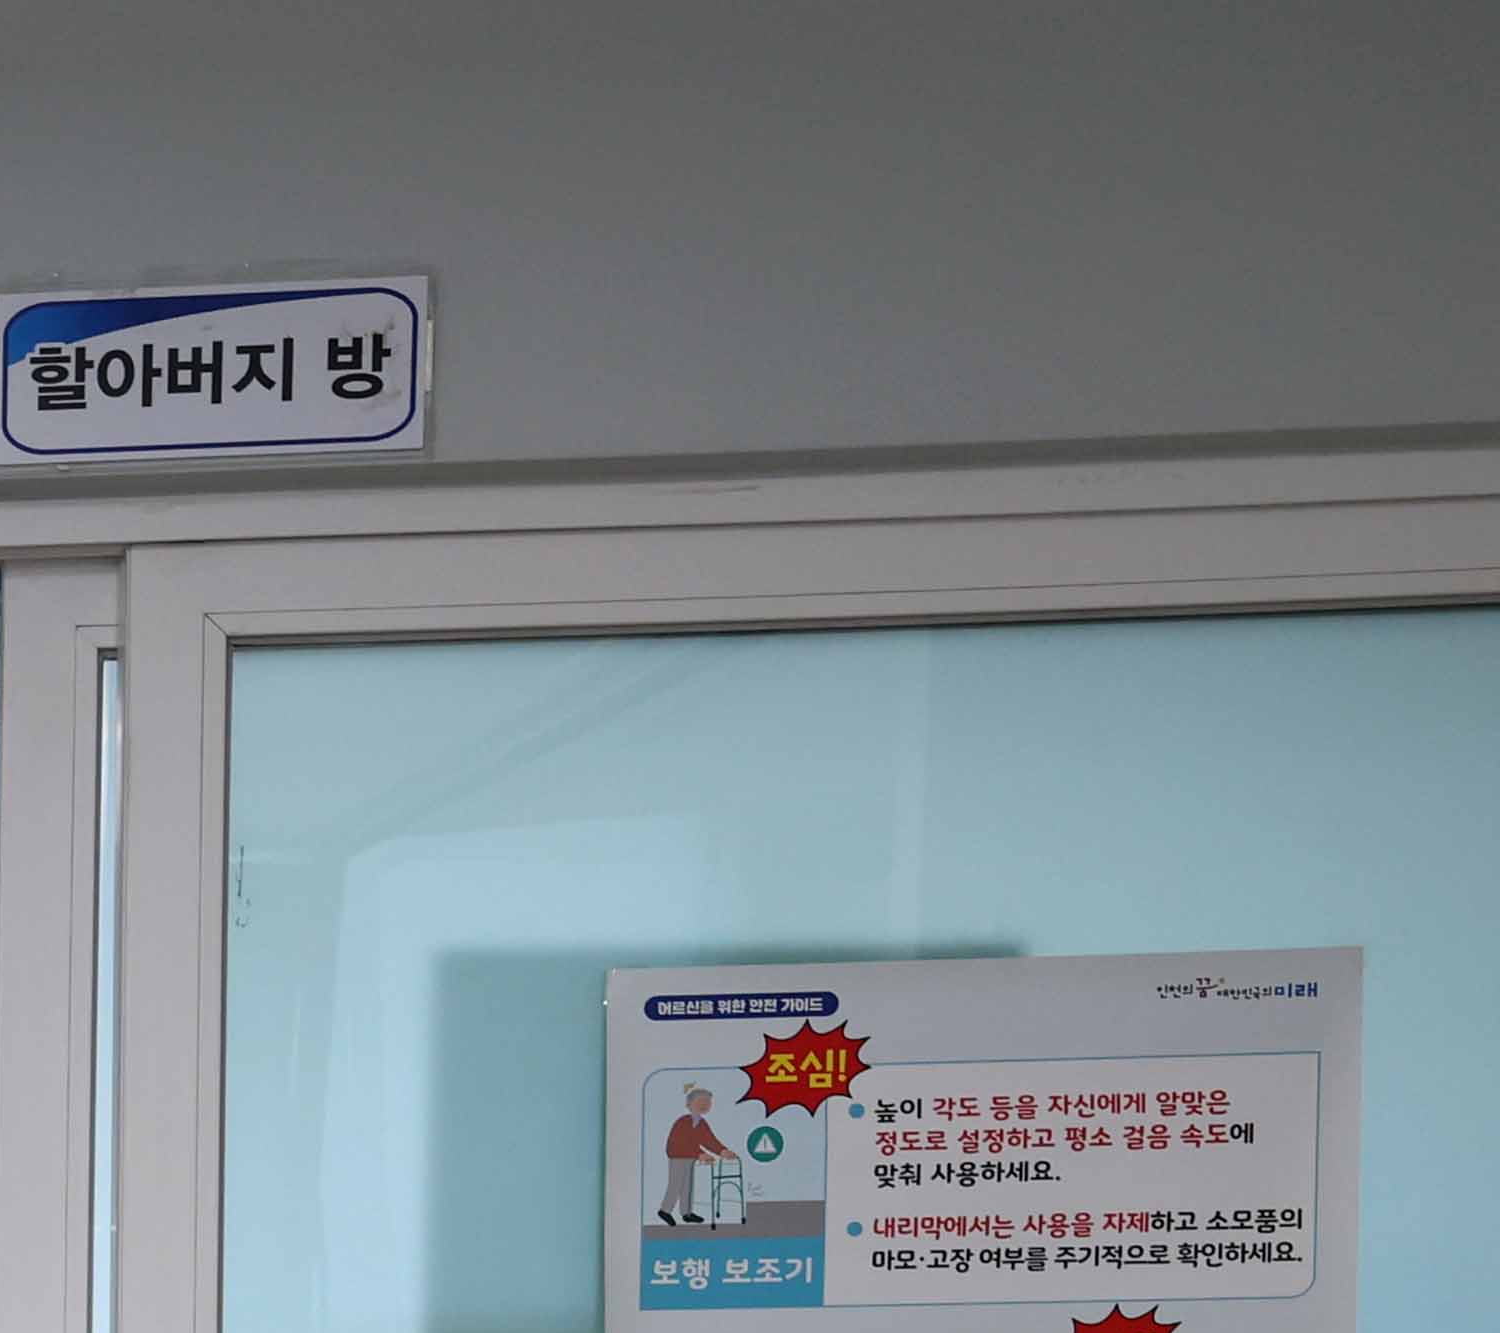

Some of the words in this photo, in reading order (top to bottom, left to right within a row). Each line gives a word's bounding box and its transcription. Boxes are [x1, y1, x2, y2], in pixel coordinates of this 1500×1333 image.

[30, 337, 295, 411] 할아버지
[327, 333, 392, 400] 방
[1275, 982, 1318, 997] 미래
[658, 1001, 713, 1015] 어르신을
[718, 999, 745, 1014] 위한
[751, 999, 776, 1013] 안전
[781, 998, 823, 1012] 가이드
[764, 1049, 848, 1089] 조심!
[874, 1098, 921, 1123] 높이
[933, 1098, 980, 1121] 각도
[990, 1095, 1038, 1121] 등을
[1048, 1093, 1145, 1118] 자신에게
[1156, 1090, 1230, 1116] 알맞은
[876, 1131, 947, 1156] 정도로
[958, 1128, 1055, 1154] 설정하고
[1065, 1127, 1112, 1151] 평소
[1124, 1124, 1171, 1150] 걸음
[1180, 1123, 1254, 1148] 속도에
[874, 1163, 921, 1188] 맞춰
[931, 1161, 1060, 1187] 사용하세요.
[874, 1215, 1014, 1240] 내리막에서는
[1023, 1212, 1094, 1238] 사용을
[1103, 1211, 1198, 1233] 자제하고
[1206, 1208, 1302, 1233] 소모품의
[651, 1256, 710, 1290] 보행
[722, 1254, 813, 1286] 보조기
[980, 1247, 1048, 1271] 여부를
[1054, 1245, 1170, 1269] 주기적으로
[1177, 1242, 1302, 1268] 확인하세요.
